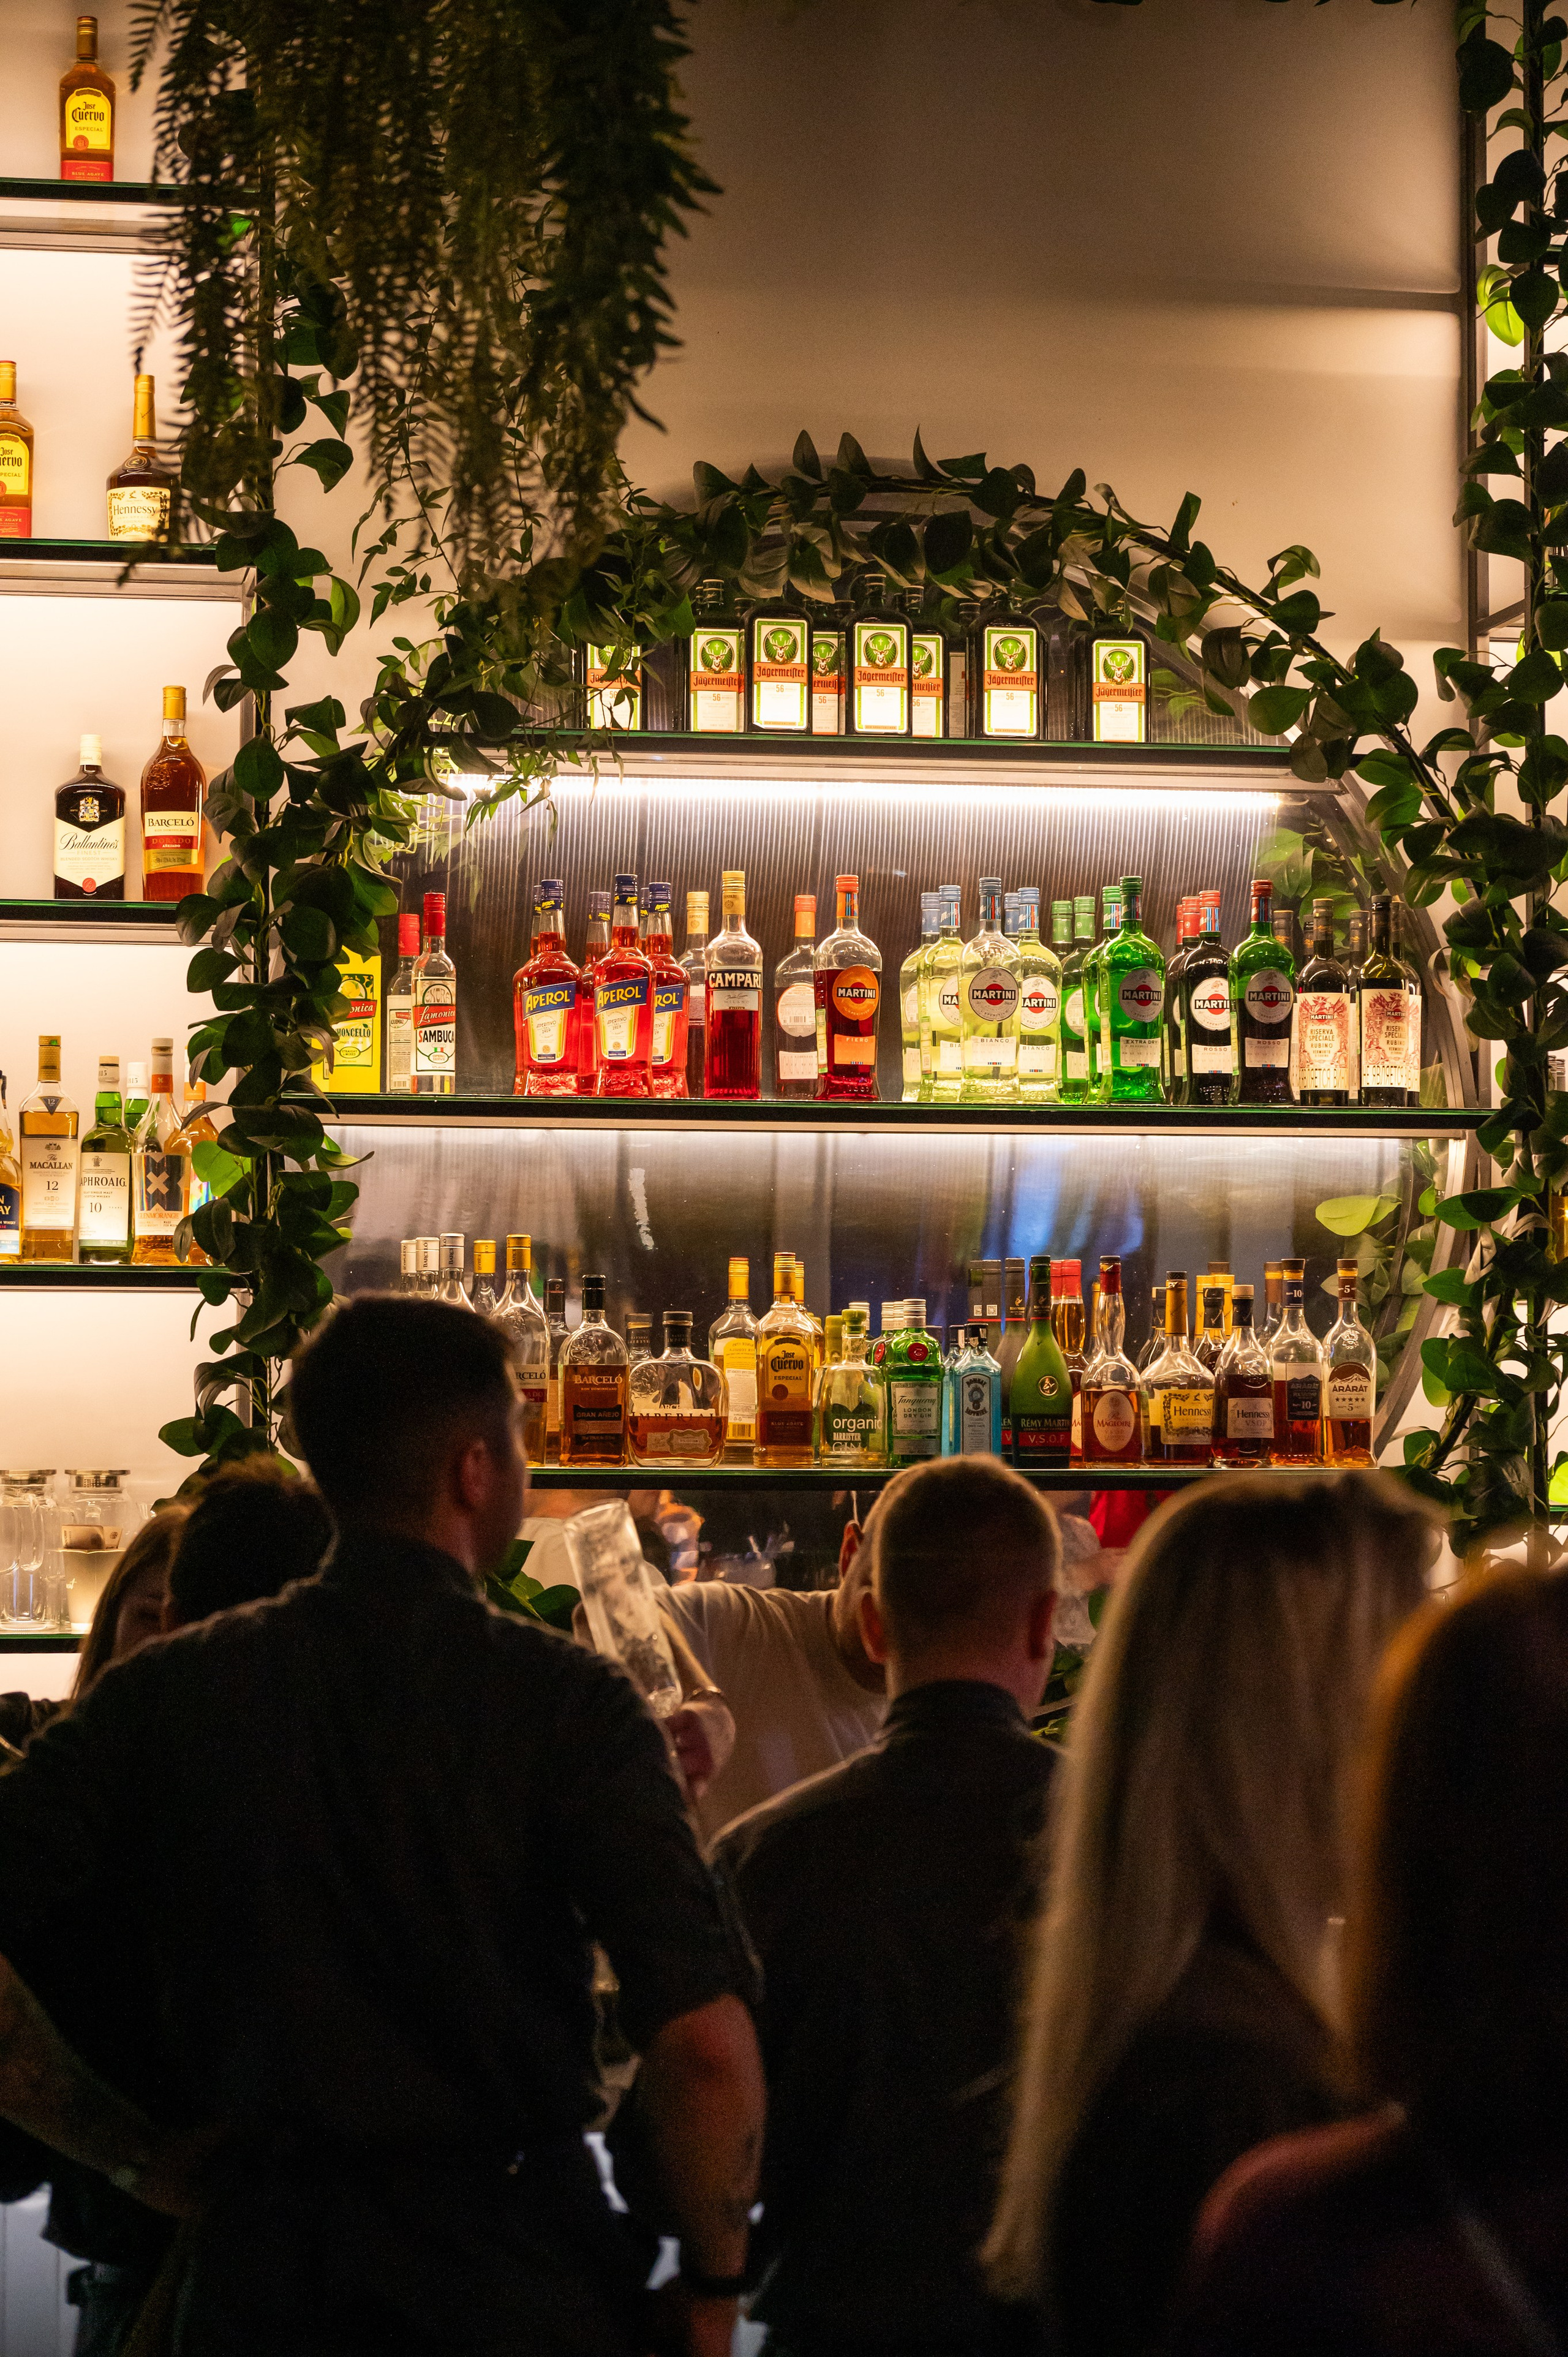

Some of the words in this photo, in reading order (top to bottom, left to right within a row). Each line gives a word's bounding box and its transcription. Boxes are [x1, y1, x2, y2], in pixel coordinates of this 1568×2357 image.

[83, 102, 96, 111] Jose
[72, 107, 105, 123] Cuervo
[0, 447, 13, 456] Jose
[113, 505, 157, 516] Hennessy
[775, 684, 785, 693] 56
[1006, 692, 1014, 701] 56
[148, 816, 194, 828] BARCELÓ
[59, 832, 119, 850] Ballantine's
[709, 973, 761, 989] CAMPARI
[425, 987, 450, 1003] EXTRA
[597, 986, 641, 1009] APEROL
[838, 988, 875, 998] MARTINI
[974, 990, 1015, 1000] MARTINI
[1124, 990, 1161, 1000] MARTINI
[1250, 992, 1289, 1001] MARTINI
[526, 990, 570, 1013] APEROL
[655, 992, 679, 1008] ROL
[1196, 1000, 1230, 1009] MARTI
[607, 1016, 627, 1025] APERITIVO
[418, 1030, 454, 1043] SAMBUCA
[46, 1180, 59, 1191] 12
[80, 1177, 126, 1187] APHROAIG
[90, 1202, 102, 1213] 10
[782, 1350, 795, 1360] Jose
[771, 1356, 804, 1372] Cuervo
[516, 1370, 546, 1381] RCELÓ
[575, 1374, 623, 1386] BARCELÓ
[1332, 1384, 1368, 1393] ARARAT
[898, 1395, 937, 1406] Tanqueray
[1302, 1401, 1311, 1409] 10
[832, 1416, 883, 1432] organic
[1021, 1418, 1041, 1427] RÉMY
[1097, 1419, 1132, 1428] MAGLOIRE
[833, 1432, 861, 1441] BARRISTER
[832, 1442, 861, 1454] GIN
